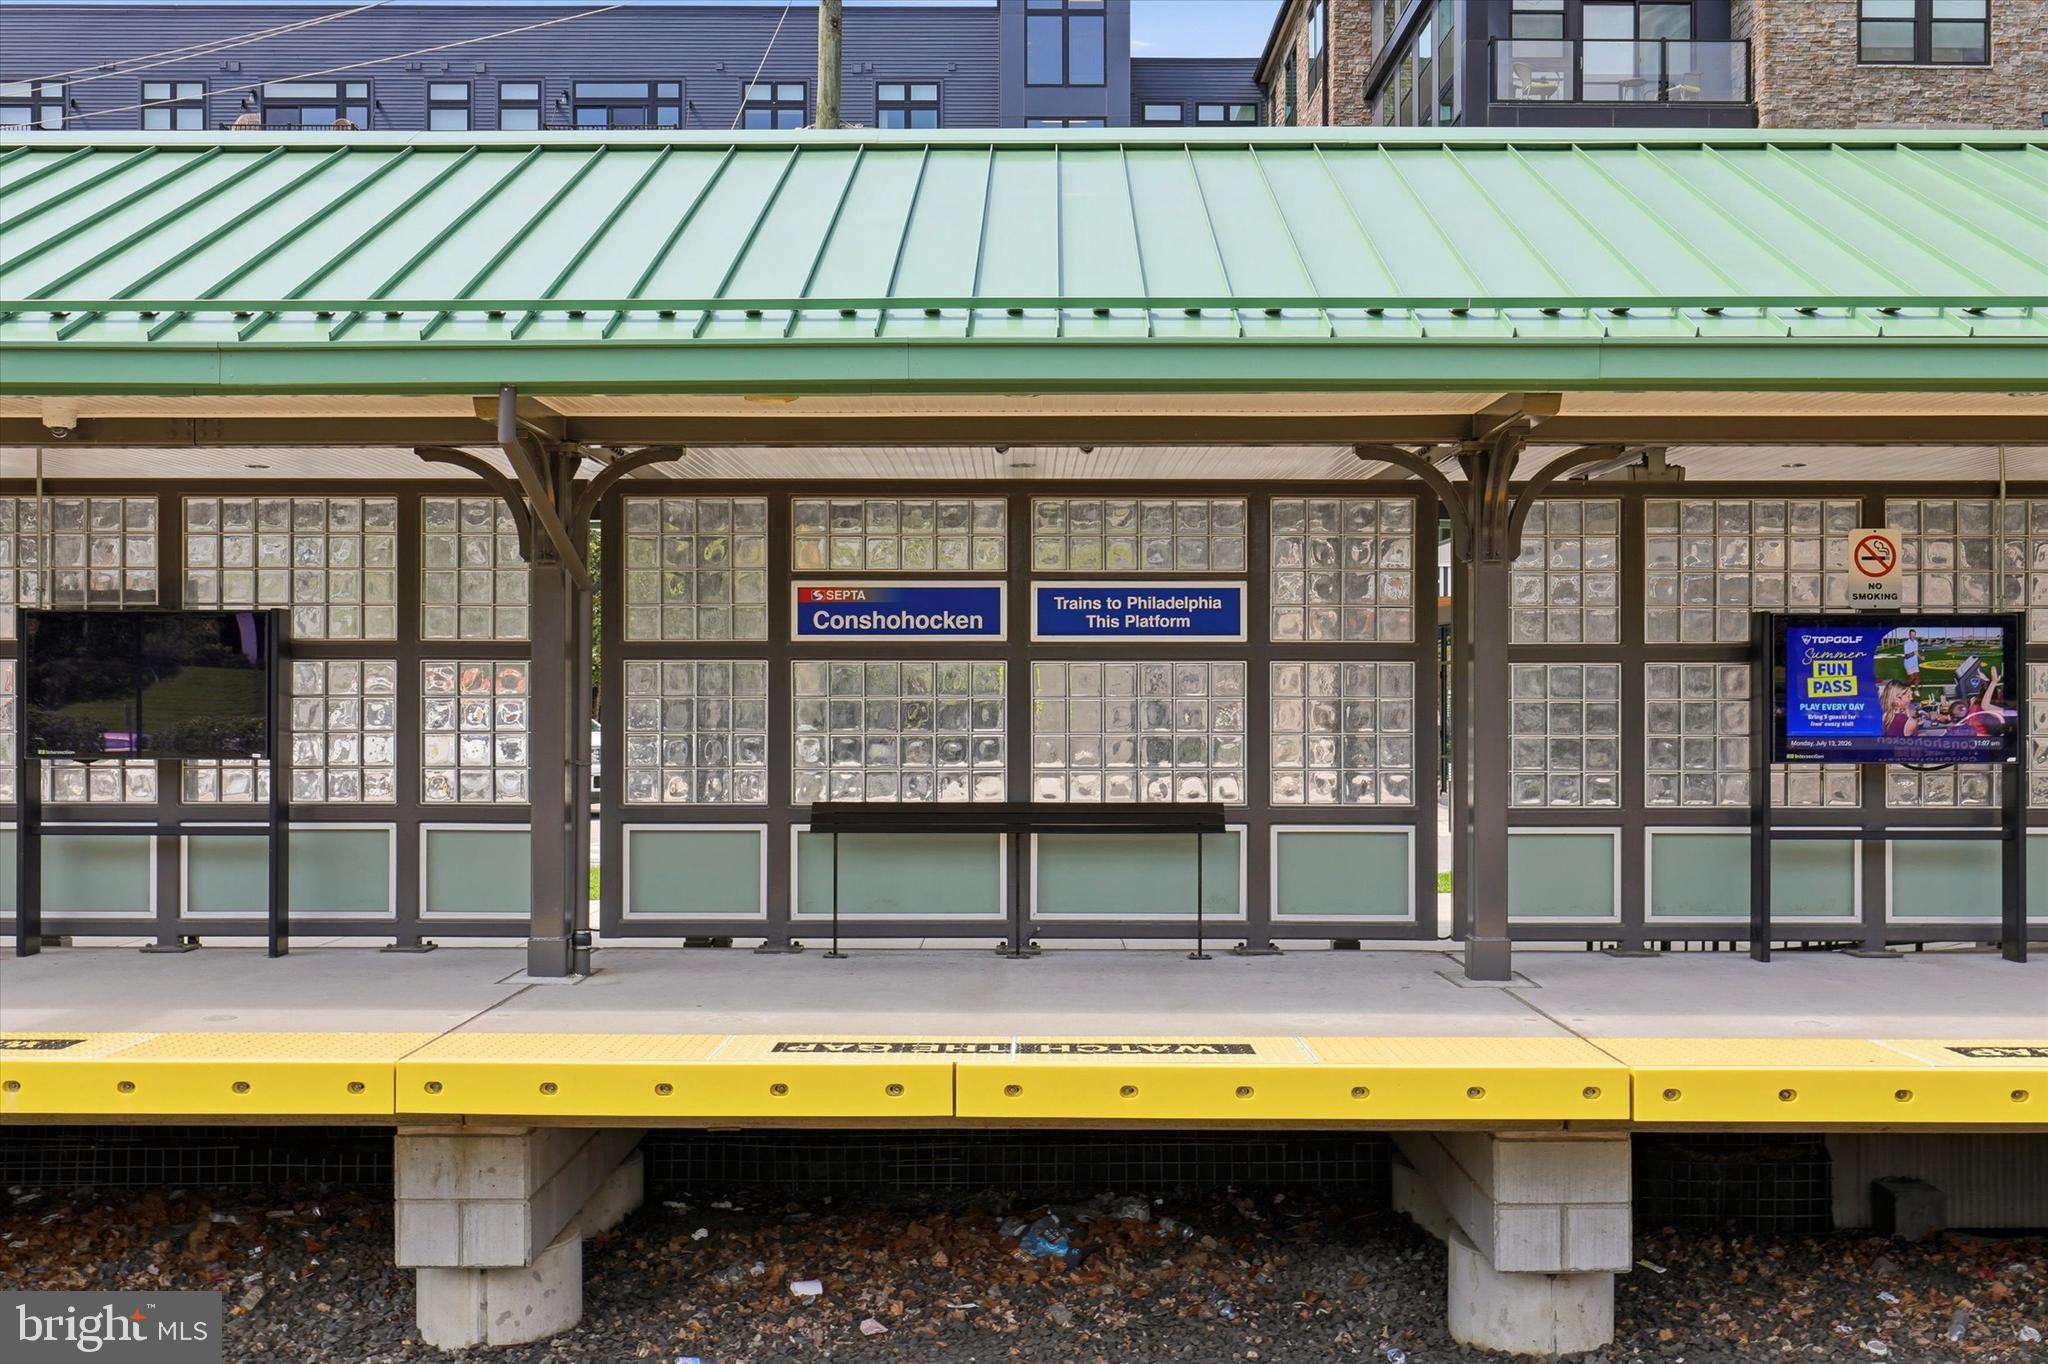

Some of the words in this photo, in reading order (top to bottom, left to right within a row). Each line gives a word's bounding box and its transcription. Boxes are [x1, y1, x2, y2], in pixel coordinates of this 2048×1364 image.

[826, 590, 866, 601] SEPTA
[1852, 593, 1898, 601] SMOKING
[1054, 596, 1102, 610] Trains
[1106, 597, 1122, 610] to
[1126, 596, 1223, 613] Philadelphia
[813, 610, 984, 630] Conshohocken
[1086, 614, 1120, 629] This
[1124, 614, 1191, 629] Platform
[1812, 635, 1863, 644] TOPGOLF
[1801, 647, 1868, 665] Summer
[1818, 663, 1847, 676] FUN
[1813, 680, 1852, 694] PASS
[1799, 703, 1820, 711] PLAY
[1821, 703, 1848, 711] EVERY
[1849, 703, 1865, 711] DAY
[786, 1043, 893, 1052] GAP
[911, 1044, 1011, 1053] THE
[1039, 1044, 1219, 1053] WATCH
